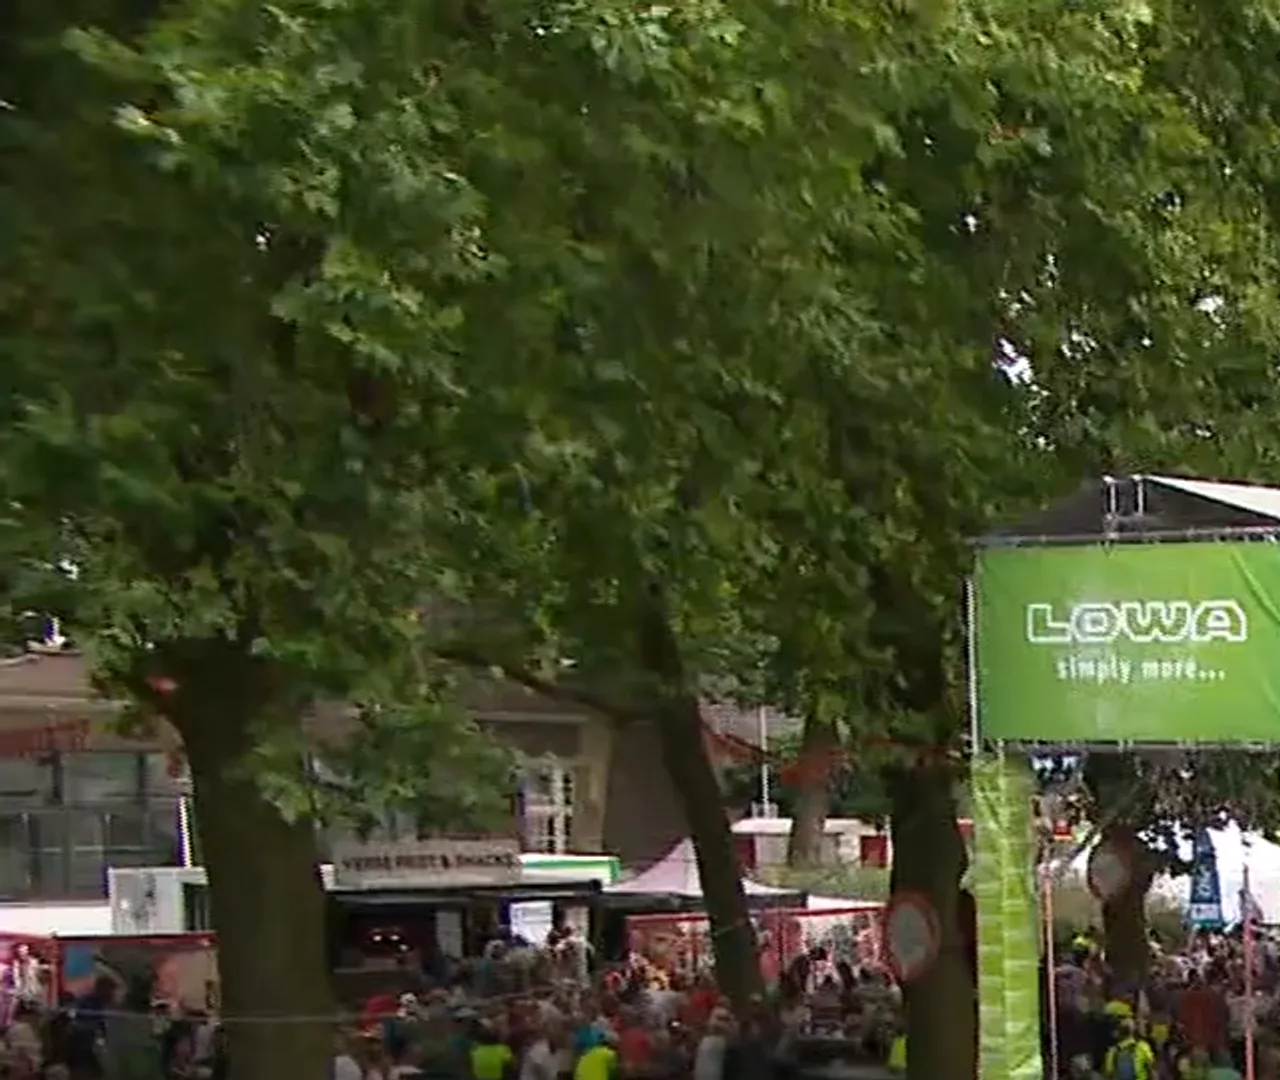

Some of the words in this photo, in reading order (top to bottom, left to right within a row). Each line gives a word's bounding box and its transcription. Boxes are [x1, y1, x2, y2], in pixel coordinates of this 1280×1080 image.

[1026, 600, 1248, 643] LOWA
[1057, 654, 1132, 685] simply
[1141, 658, 1226, 681] more...
